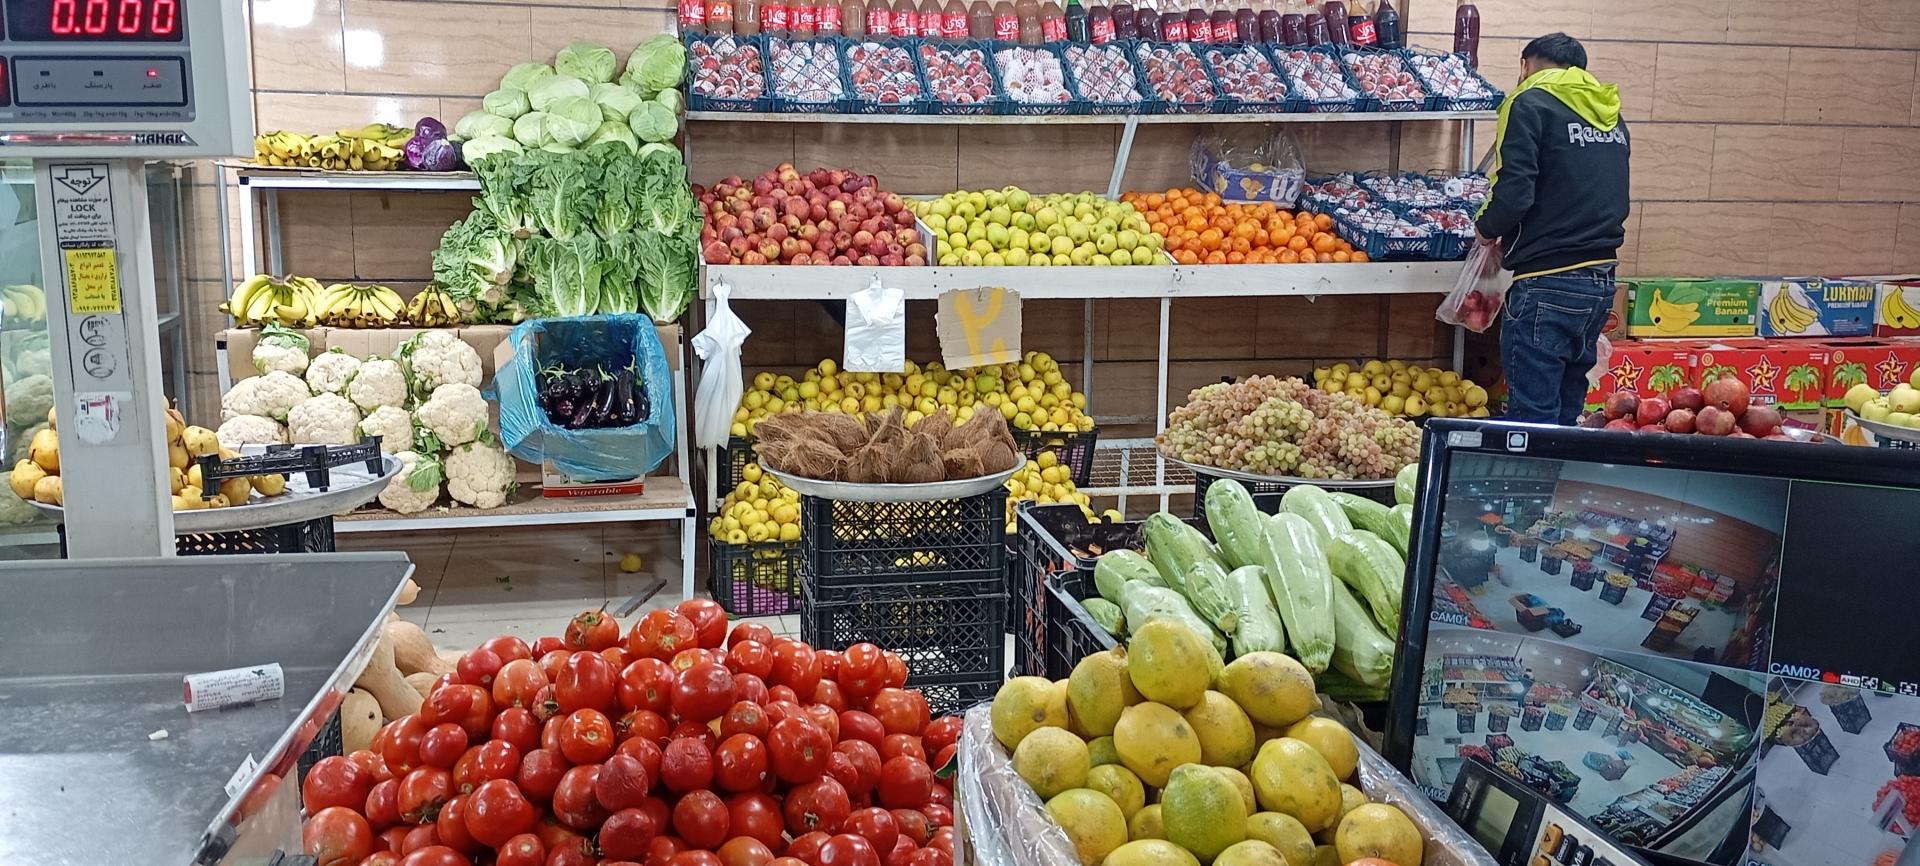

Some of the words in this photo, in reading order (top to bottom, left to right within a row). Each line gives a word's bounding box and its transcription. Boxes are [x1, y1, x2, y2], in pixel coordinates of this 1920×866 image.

[51, 0, 175, 33] 0.000
[135, 133, 184, 144] MAHAK
[70, 177, 91, 188] توجه
[70, 204, 96, 212] LOCK
[1823, 286, 1874, 302] LUKMAN
[1707, 298, 1748, 307] Premium
[1714, 307, 1749, 316] Banana
[567, 487, 622, 497] Vegetable
[1430, 610, 1468, 625] CAM01
[1770, 662, 1821, 681] CAM02
[1417, 786, 1447, 799] AM03
